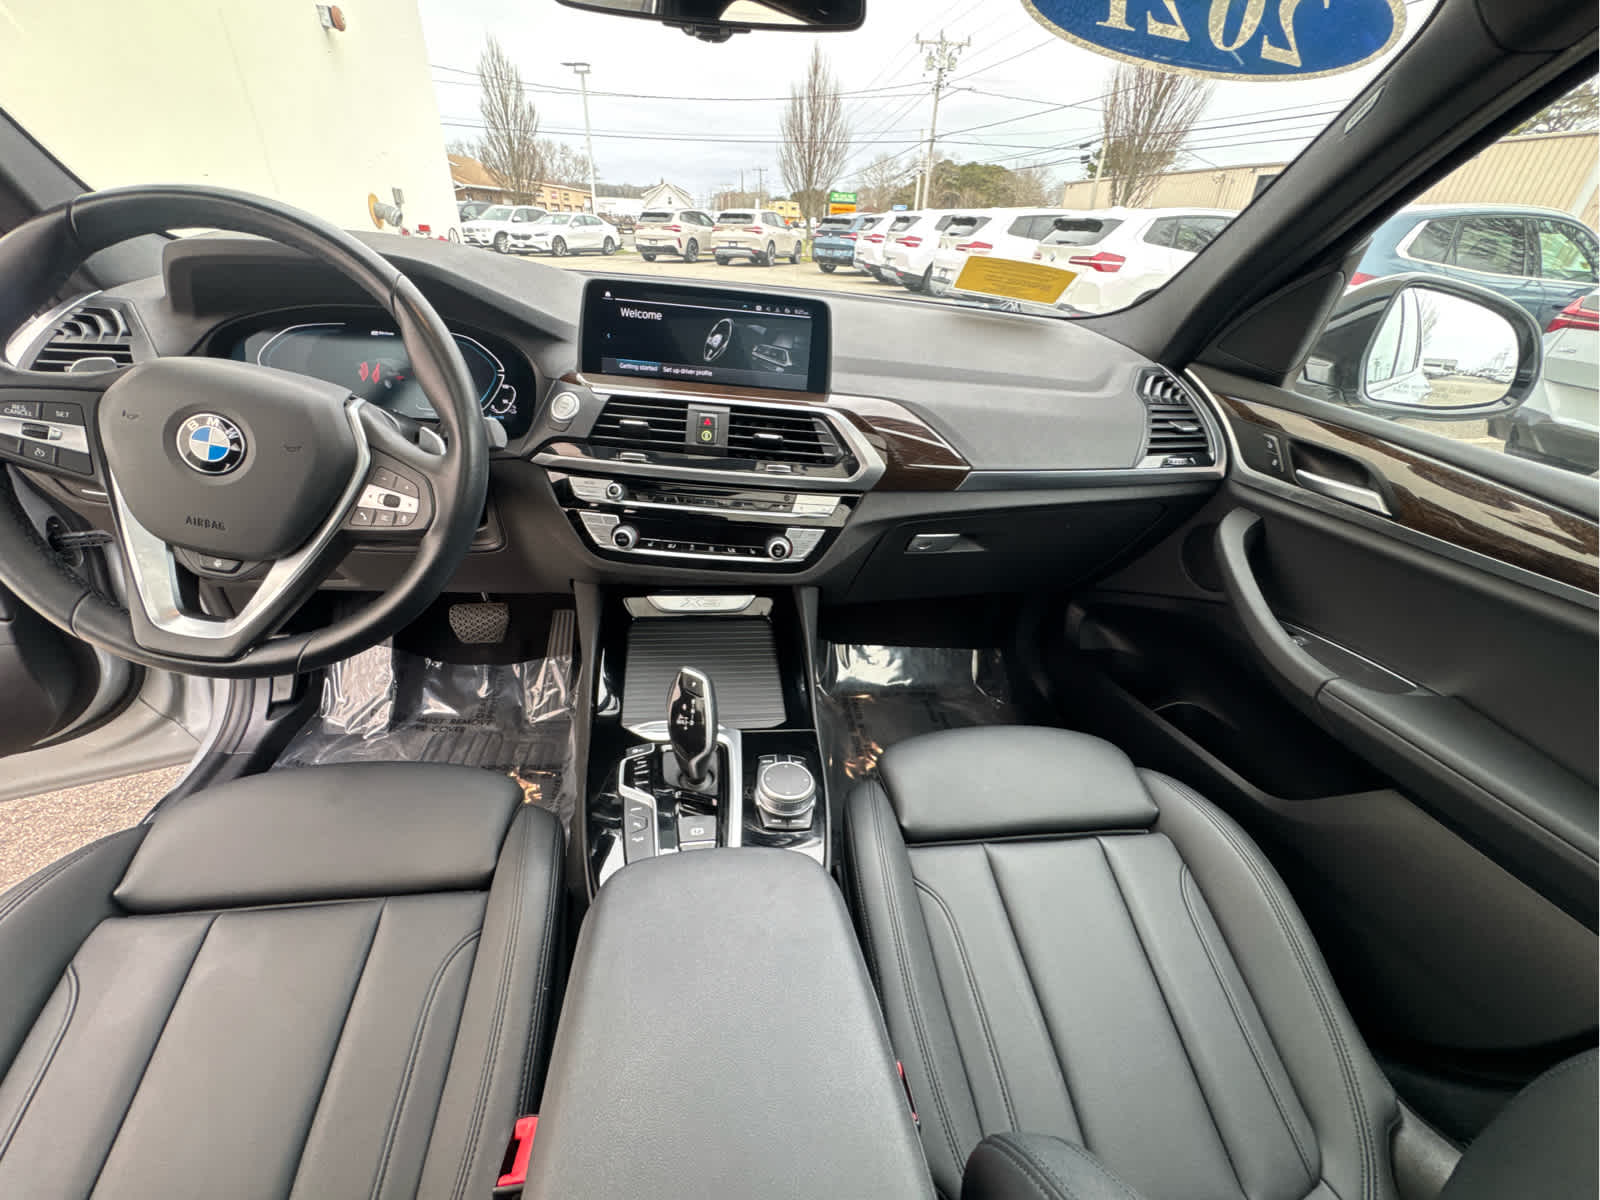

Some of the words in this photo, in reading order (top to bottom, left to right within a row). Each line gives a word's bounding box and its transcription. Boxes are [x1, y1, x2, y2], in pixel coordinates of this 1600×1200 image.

[620, 307, 663, 320] Welcome
[56, 410, 70, 418] SET
[187, 416, 240, 439] BMW
[185, 515, 226, 530] AIRBAG
